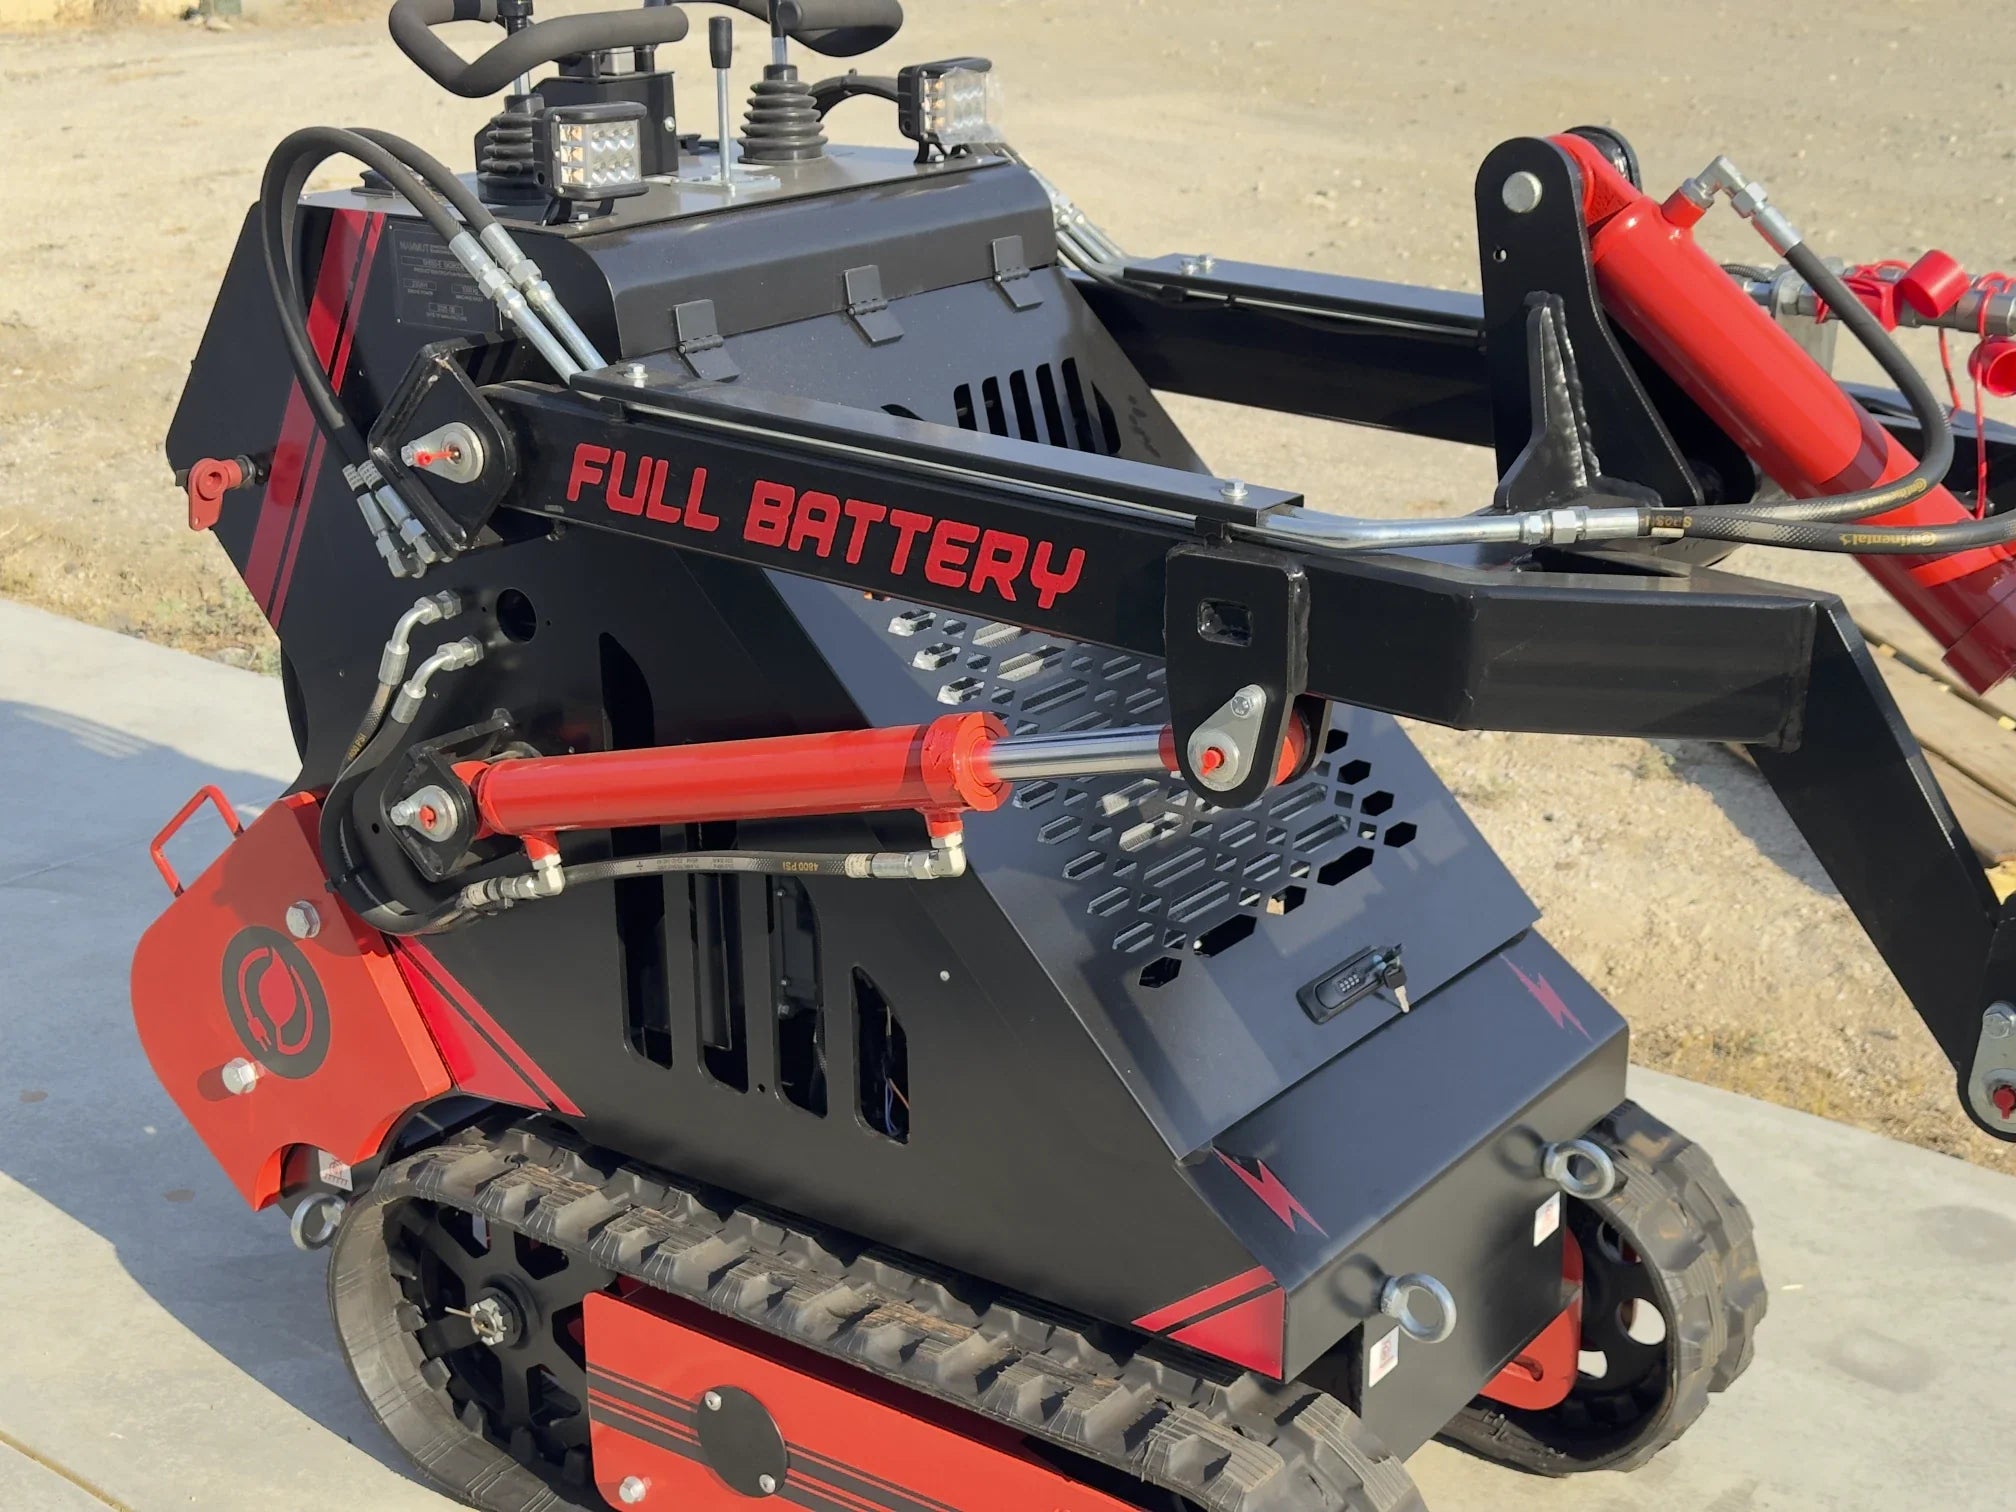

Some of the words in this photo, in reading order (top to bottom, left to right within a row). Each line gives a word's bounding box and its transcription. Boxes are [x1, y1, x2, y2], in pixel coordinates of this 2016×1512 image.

[566, 443, 720, 532] FULL
[743, 479, 1086, 610] BATTERY
[355, 732, 366, 747] PSI
[782, 861, 798, 871] PSI
[798, 861, 819, 871] 4800
